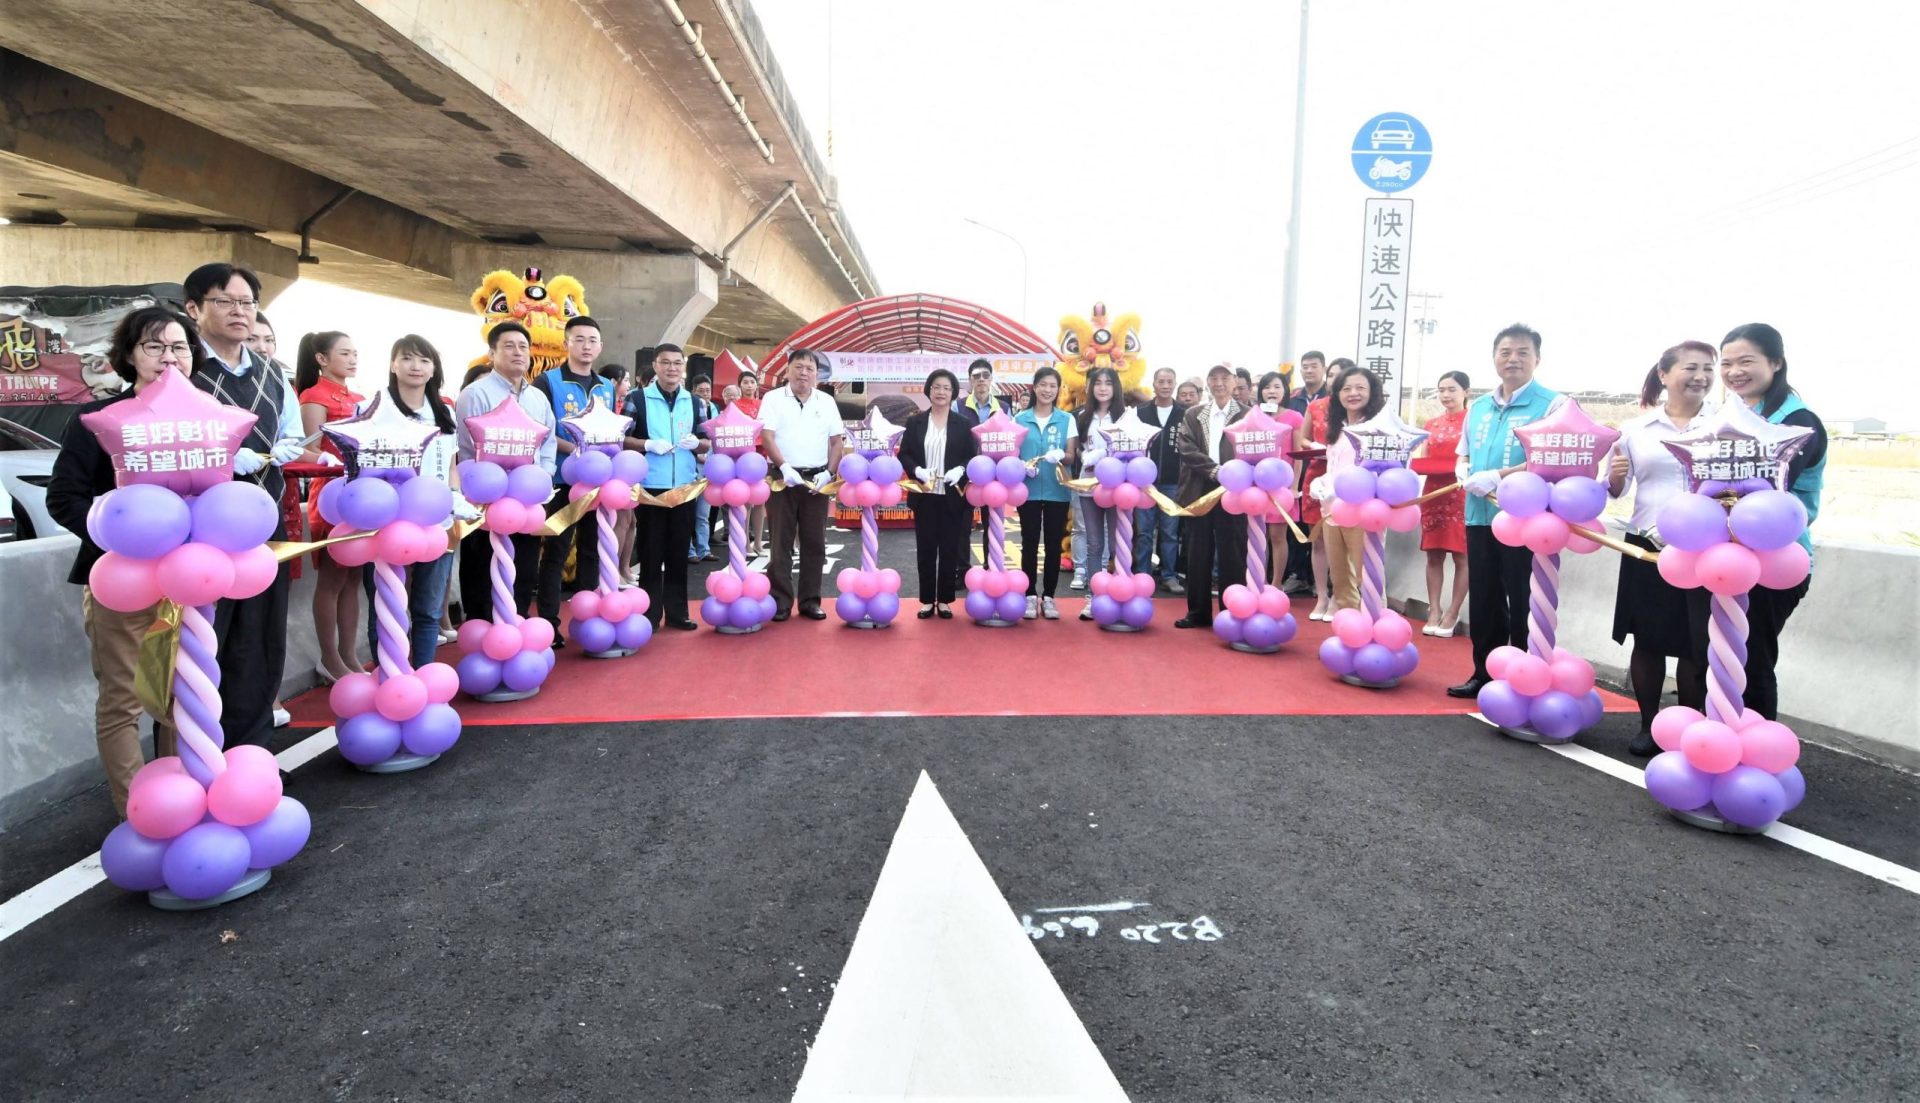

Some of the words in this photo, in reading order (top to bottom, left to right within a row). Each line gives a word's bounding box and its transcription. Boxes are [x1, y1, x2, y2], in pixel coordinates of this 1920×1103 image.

[1366, 207, 1403, 404] 快速公路專
[121, 419, 228, 447] 美好彰化
[1529, 432, 1596, 449] 美好彰化
[123, 447, 228, 473] 希望城市
[357, 452, 421, 468] 希望城市
[1530, 450, 1593, 466] 希望城市
[1691, 461, 1778, 479] 希望城市
